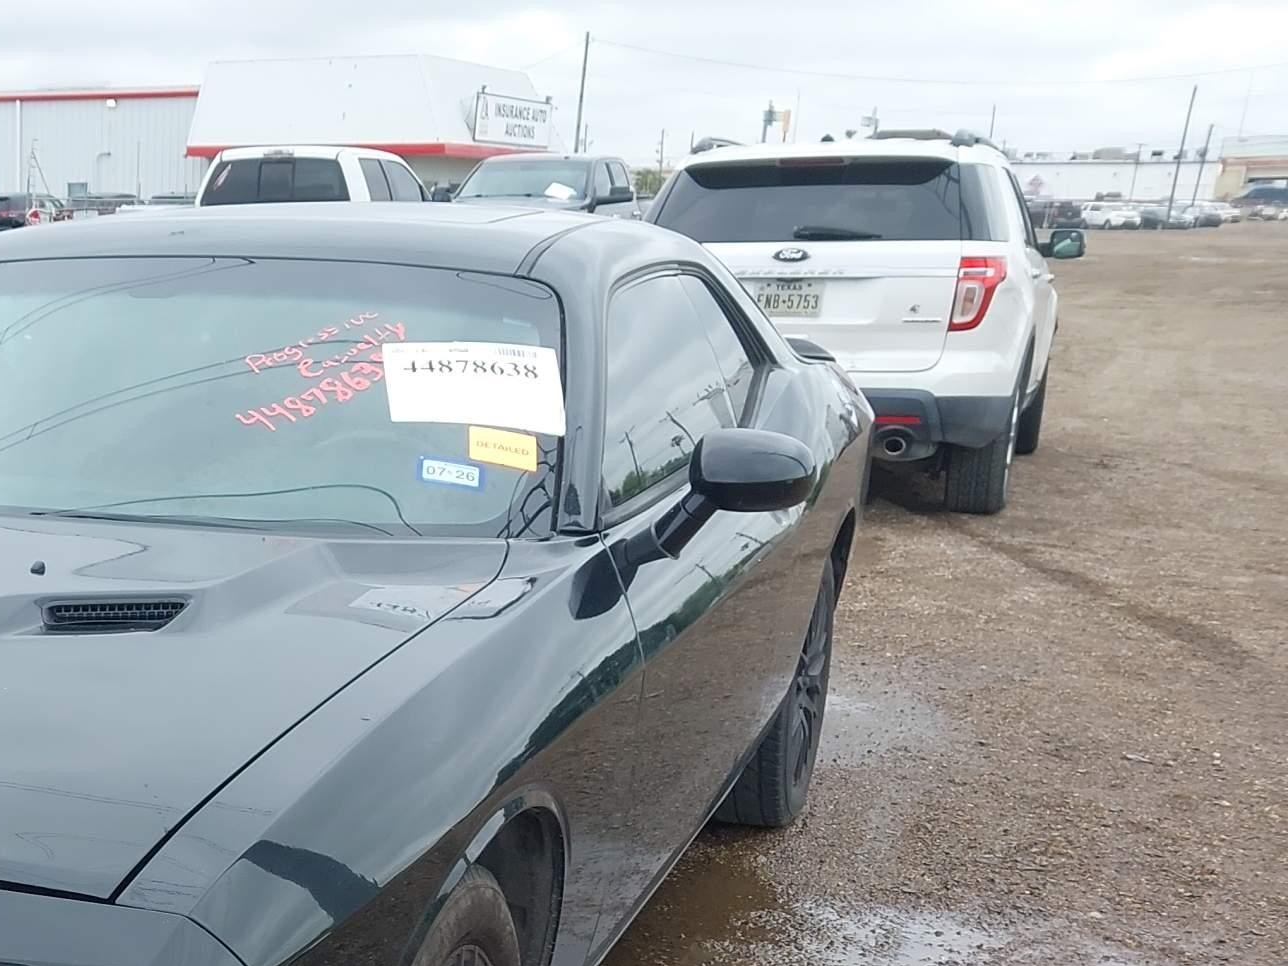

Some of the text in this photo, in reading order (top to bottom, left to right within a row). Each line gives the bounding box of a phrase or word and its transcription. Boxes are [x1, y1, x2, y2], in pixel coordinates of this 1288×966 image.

[494, 102, 531, 121] INSURANCE
[531, 107, 548, 123] AUTO
[504, 122, 536, 139] AUCTIONS
[777, 248, 805, 260] Ford
[776, 283, 803, 291] TEXAS
[402, 359, 540, 380] 44878638
[235, 351, 384, 432] 4487863
[475, 439, 530, 457] DETAILED
